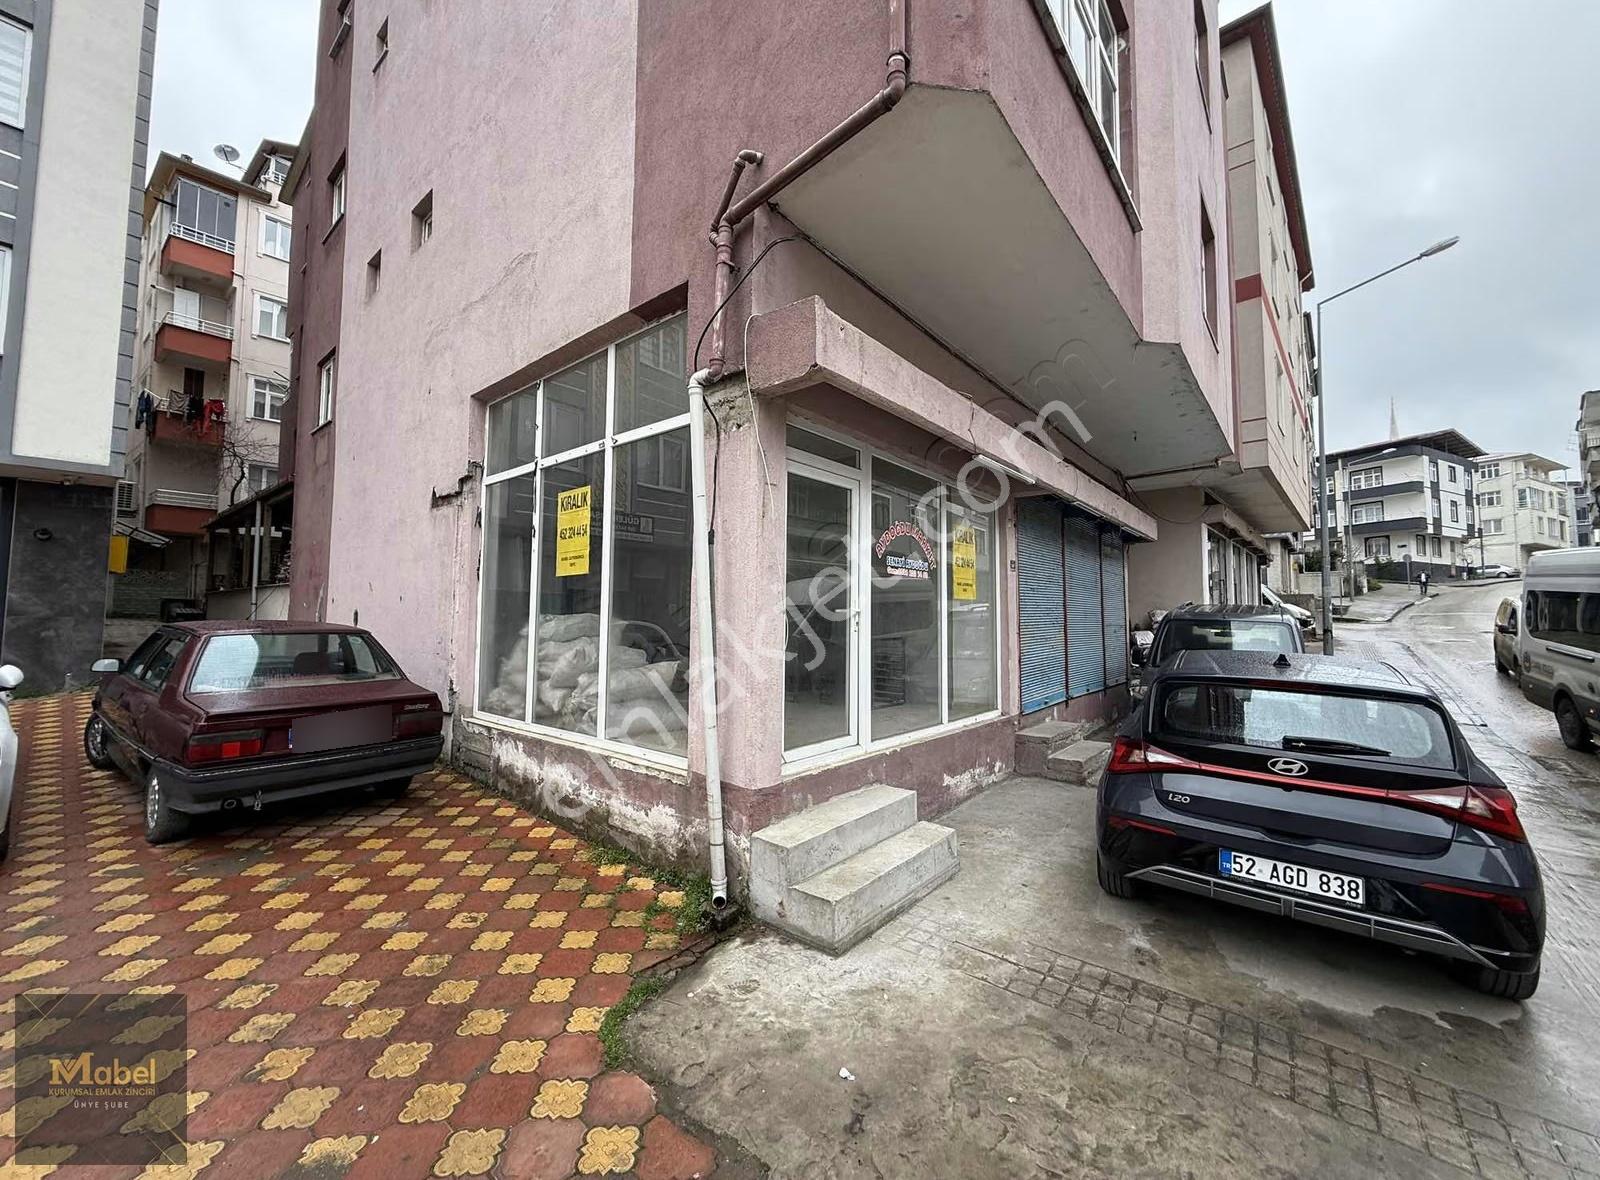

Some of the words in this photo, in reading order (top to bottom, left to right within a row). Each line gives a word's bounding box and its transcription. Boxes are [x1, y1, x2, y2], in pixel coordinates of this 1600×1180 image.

[1232, 854, 1256, 877] 52
[1269, 863, 1308, 888] AGD
[1319, 873, 1360, 900] 838
